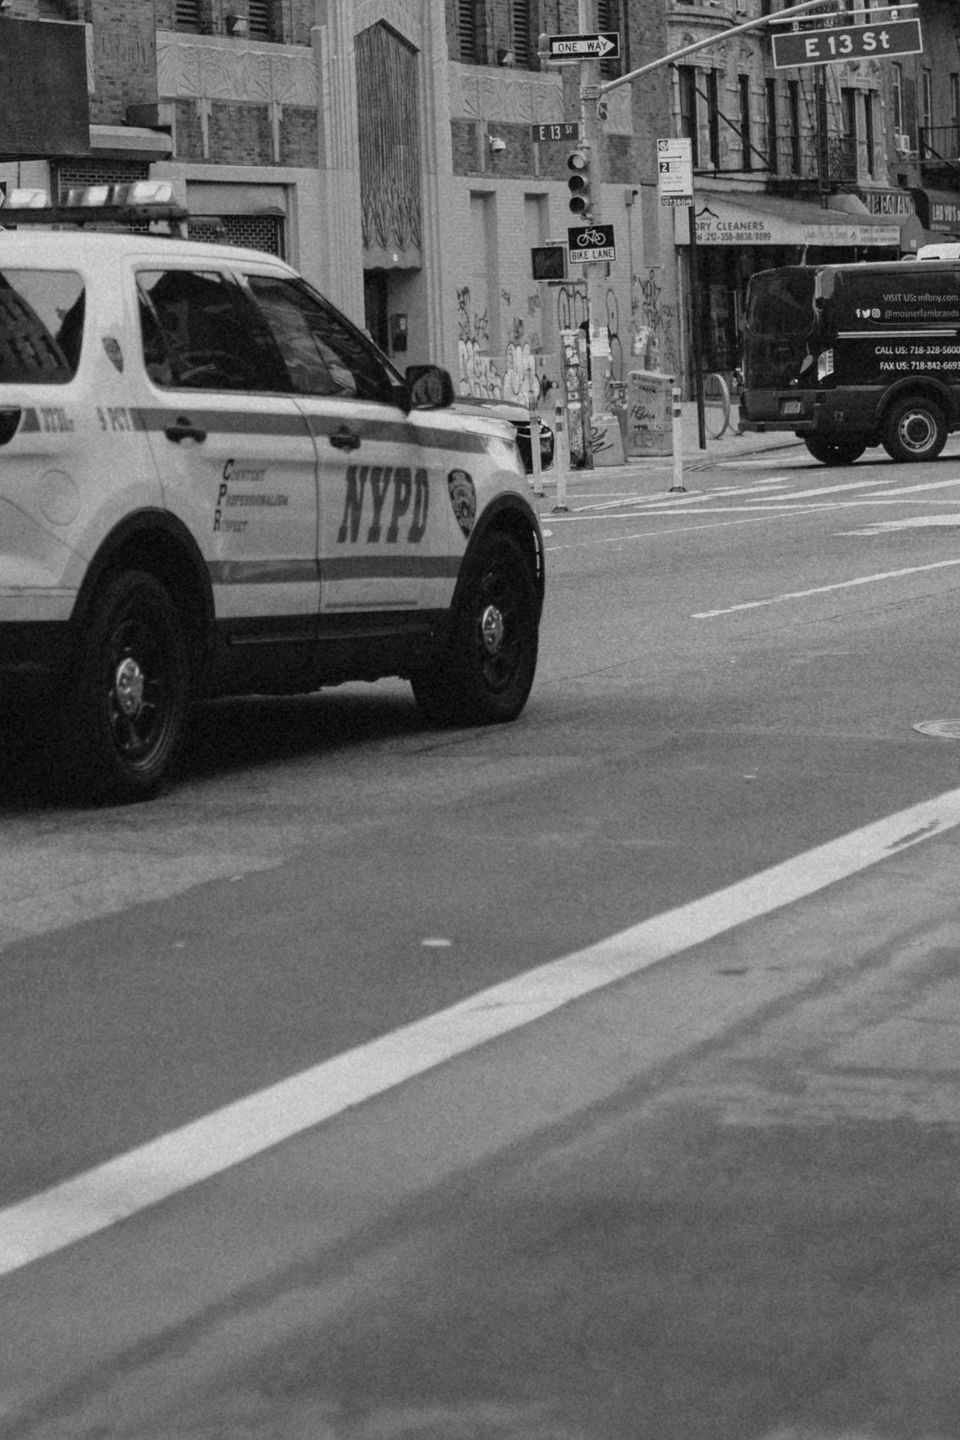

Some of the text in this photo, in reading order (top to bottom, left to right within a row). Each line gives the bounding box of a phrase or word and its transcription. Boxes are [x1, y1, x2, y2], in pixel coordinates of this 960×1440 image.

[557, 41, 608, 52] ONE WAY
[804, 30, 890, 57] E 13 St
[539, 126, 546, 140] E
[550, 125, 561, 140] 13
[661, 162, 668, 172] 2
[716, 221, 764, 231] CLEANERS
[571, 248, 614, 261] BIKE LANE
[883, 293, 959, 303] VISIT US: mfbny.com
[874, 346, 894, 355] CALL
[895, 346, 908, 355] US:
[880, 362, 894, 370] FAX
[896, 362, 910, 370] US:
[336, 465, 430, 544] NYPD
